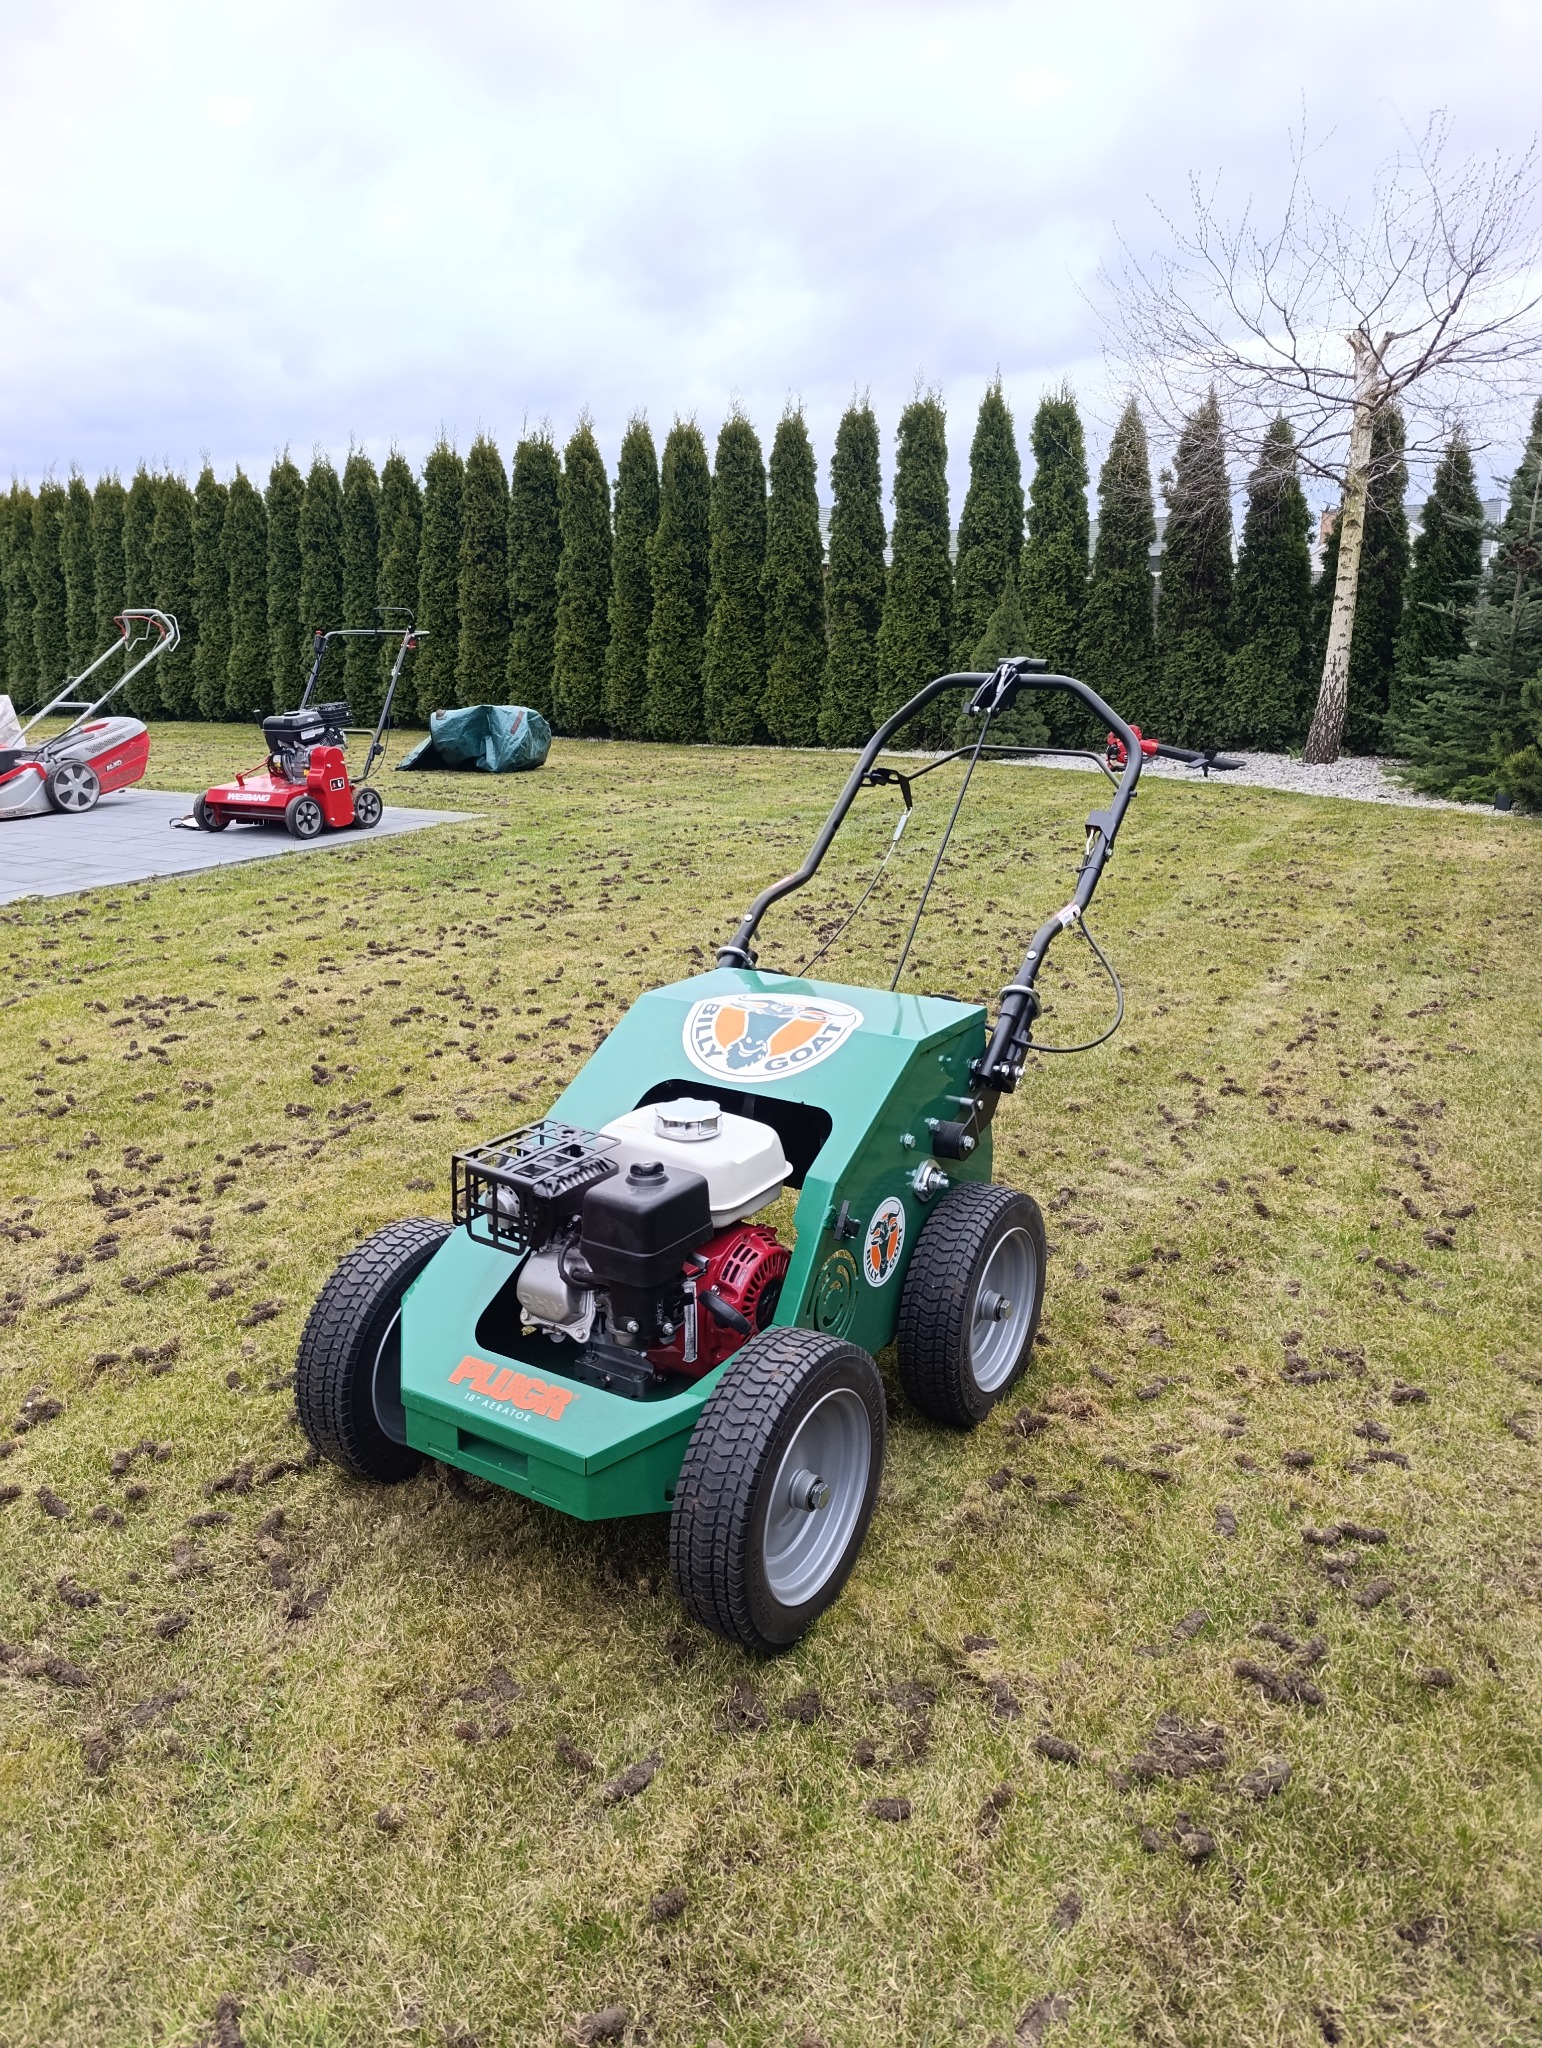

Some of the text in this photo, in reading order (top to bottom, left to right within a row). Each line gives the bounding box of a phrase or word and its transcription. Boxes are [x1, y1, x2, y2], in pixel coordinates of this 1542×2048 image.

[227, 792, 271, 802] WEIBANG
[695, 1003, 841, 1071] BILLY GOAT
[448, 1355, 573, 1422] PLUGR
[481, 1400, 532, 1423] AERATOR
